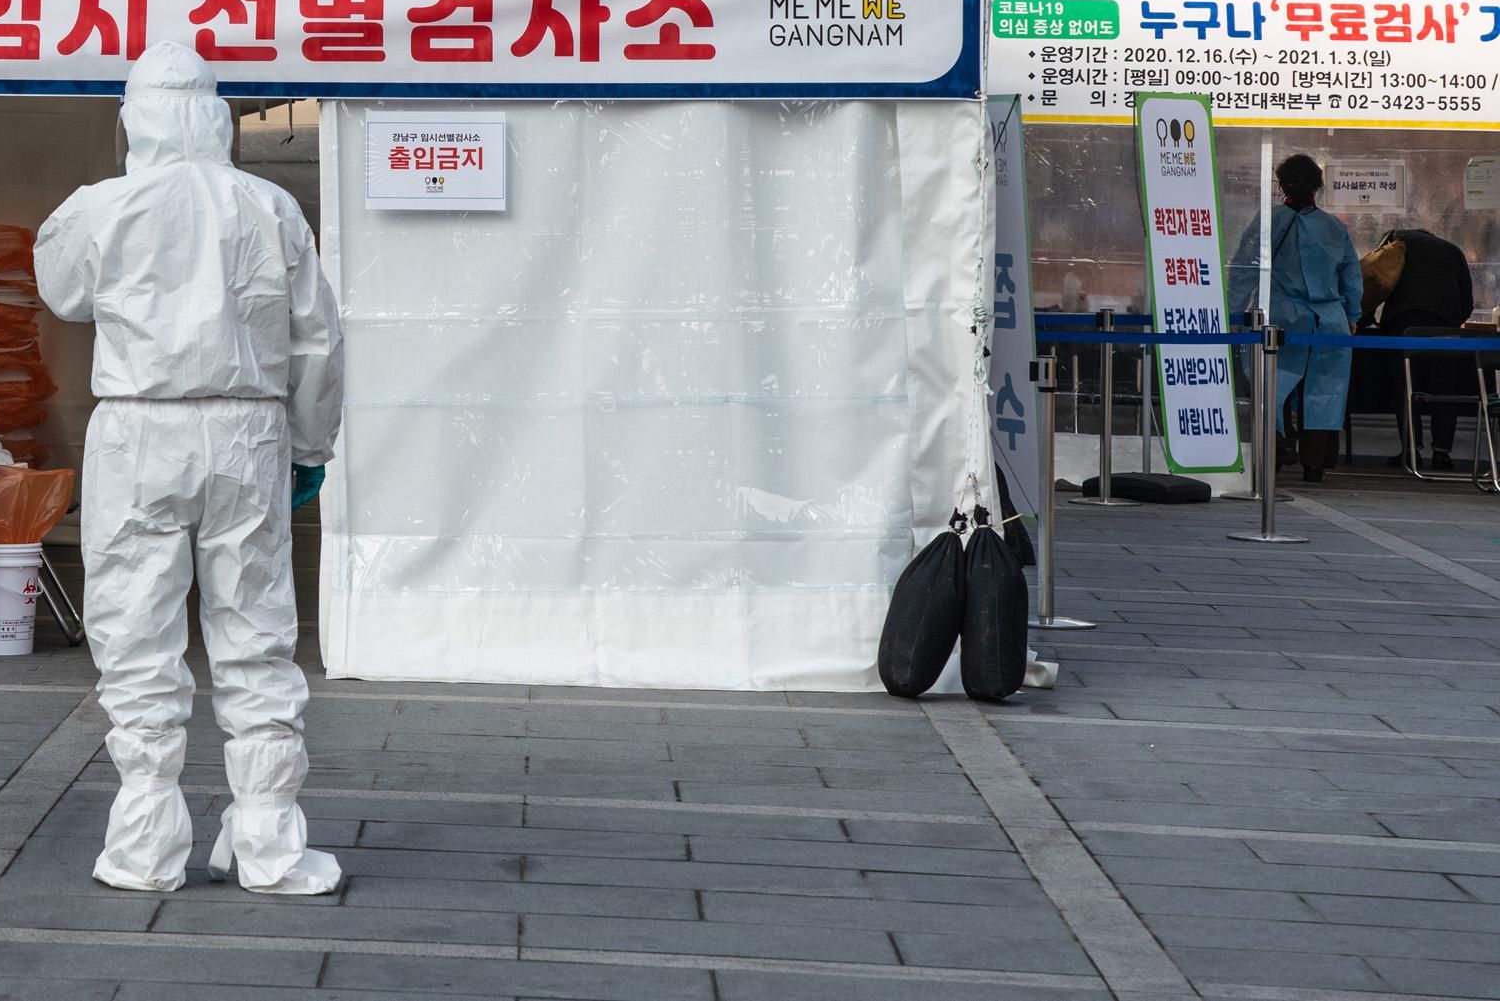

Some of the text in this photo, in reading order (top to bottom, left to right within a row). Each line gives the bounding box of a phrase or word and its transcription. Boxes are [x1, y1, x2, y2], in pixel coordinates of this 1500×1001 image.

[998, 1, 1064, 16] 코로나19
[999, 19, 1114, 36] 의심 증상 없어도
[1140, 1, 1266, 40] 누구나
[769, 23, 903, 46] GANGNAM
[1041, 46, 1108, 63] 운영기간
[1041, 68, 1108, 85] 운영시간
[1124, 68, 1169, 86] [평일]
[1175, 70, 1280, 86] 09:00~18:00
[1292, 70, 1373, 88] [방역시간]
[1380, 73, 1487, 89] 13:00~14:00
[392, 133, 481, 143] 강남구 임시선별검사소
[388, 146, 483, 170] 출입금지
[1161, 166, 1197, 177] GANGNAM
[1154, 207, 1212, 236] 확진자 밀접
[1164, 257, 1210, 286] 접촉자는
[1164, 307, 1220, 333] 보건소에서
[1164, 357, 1230, 386] 검사받으시기
[1178, 407, 1229, 436] 바랍니다.
